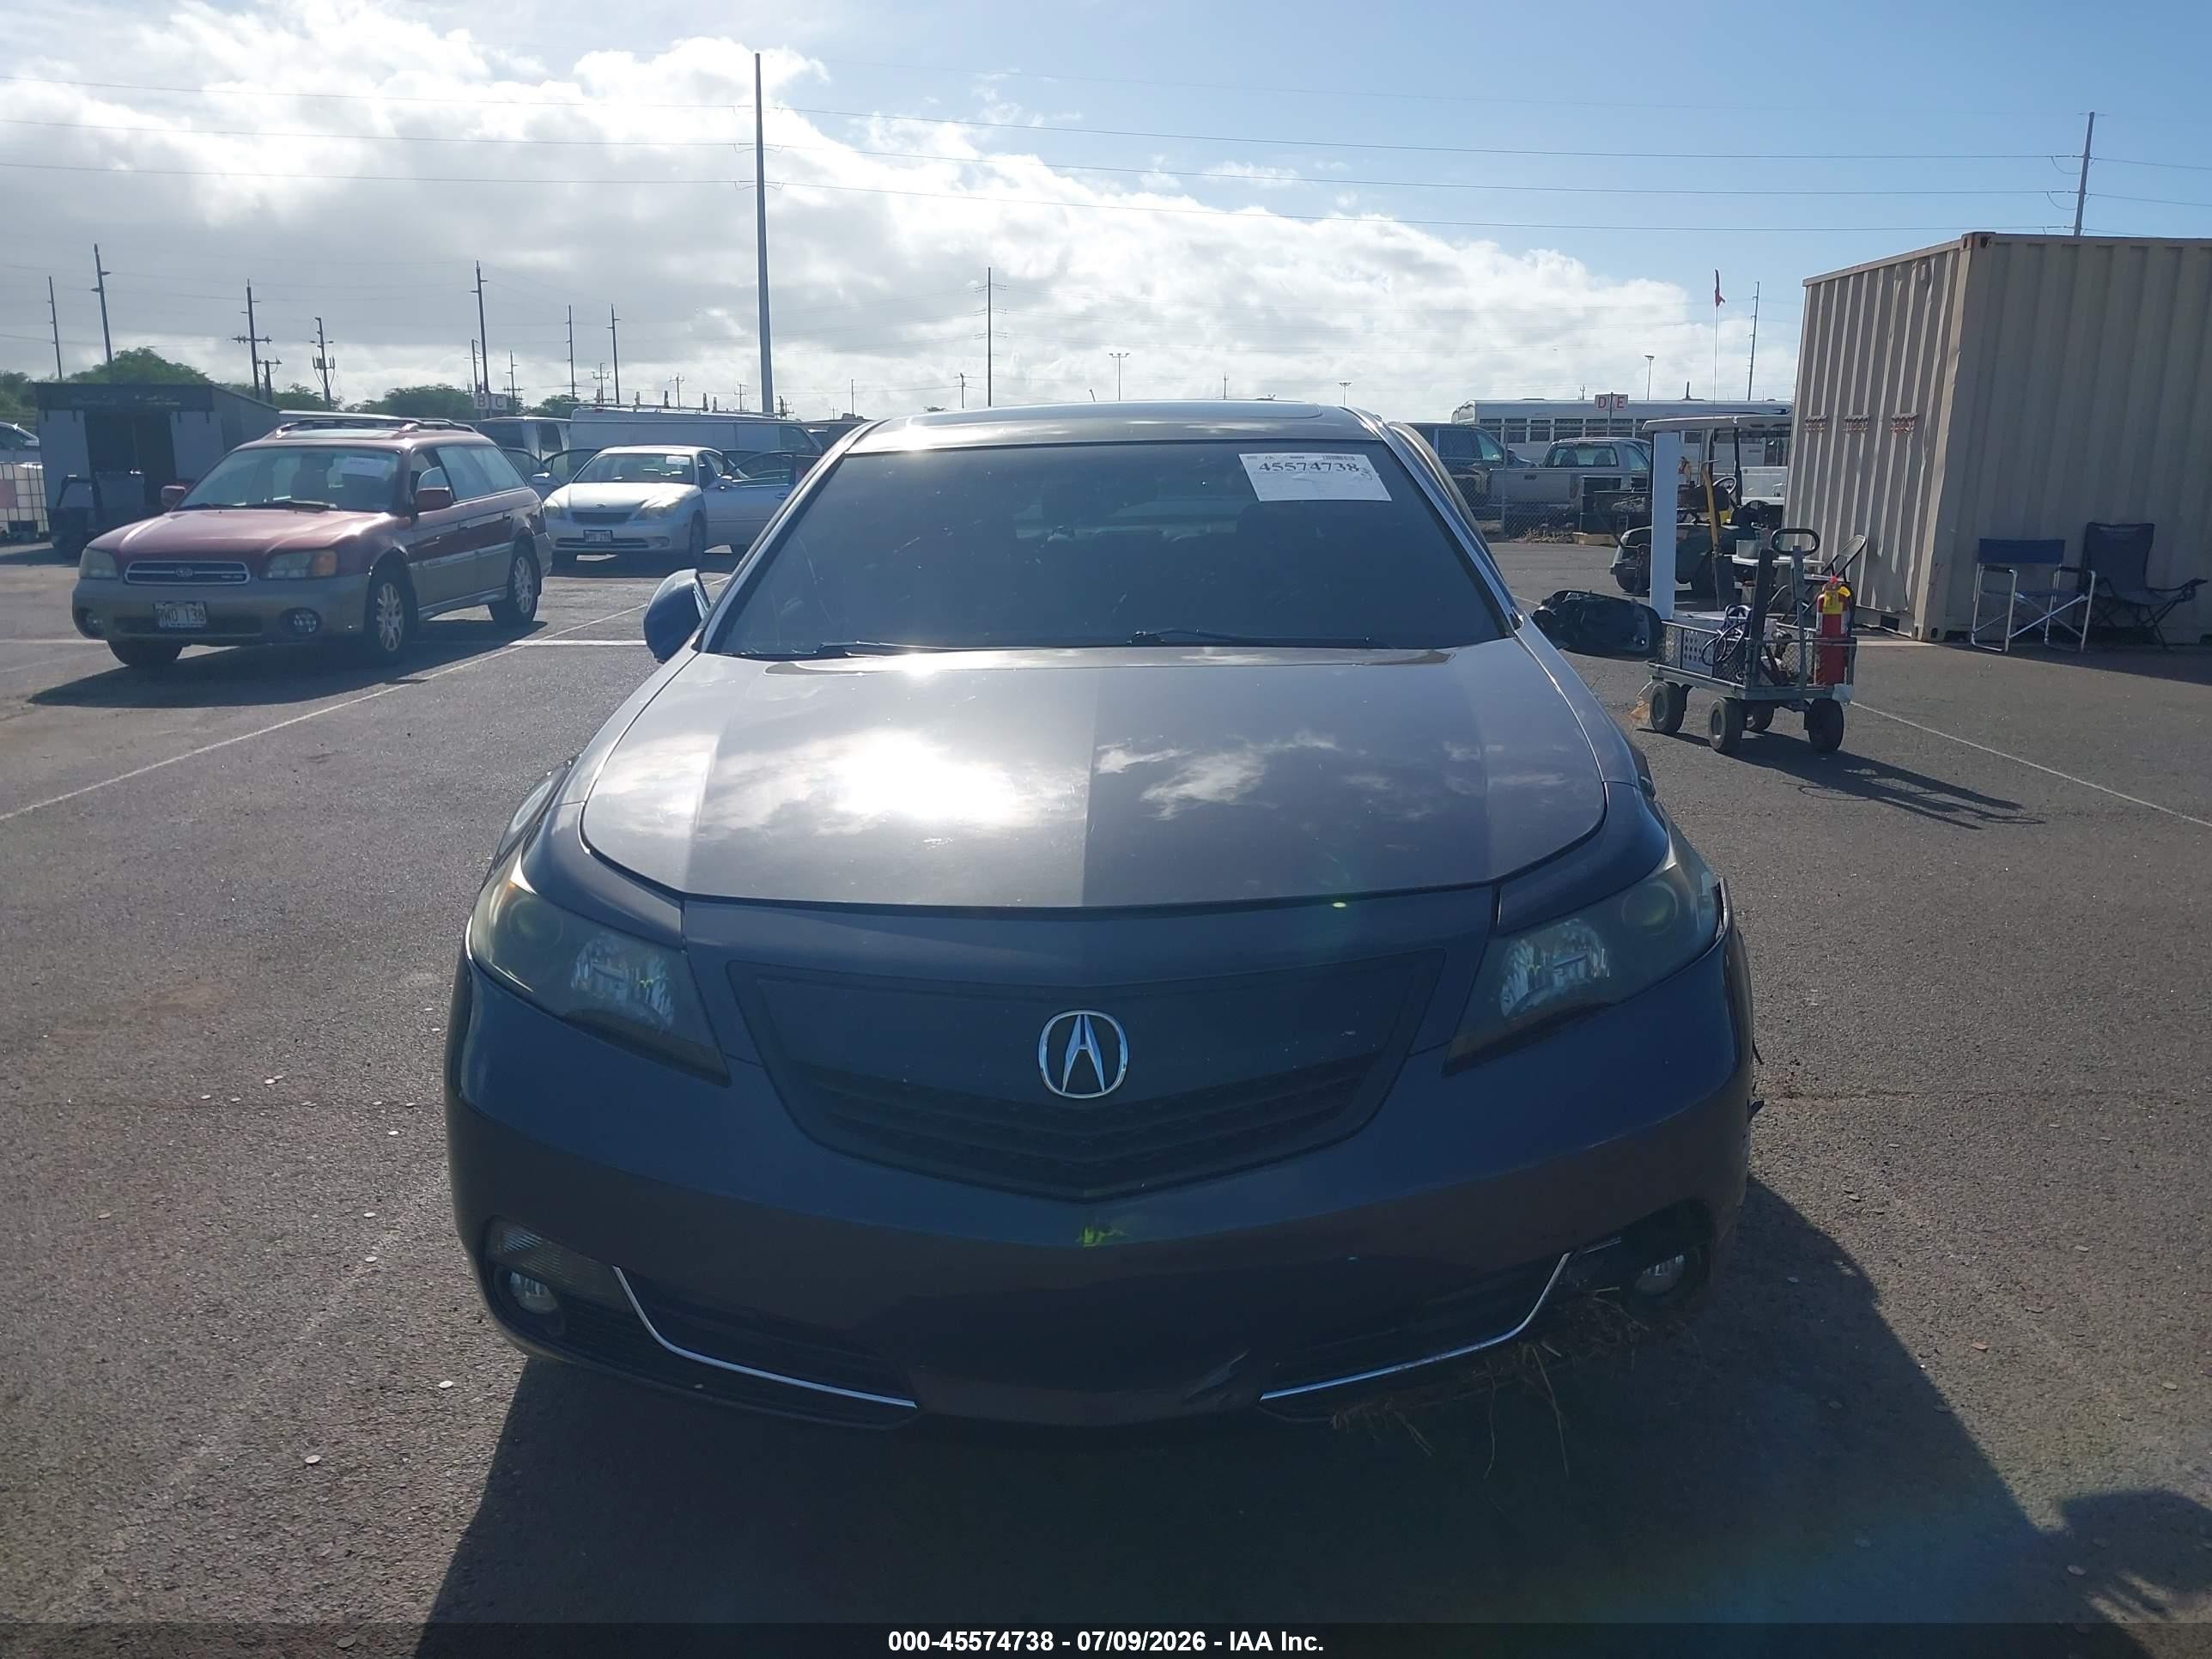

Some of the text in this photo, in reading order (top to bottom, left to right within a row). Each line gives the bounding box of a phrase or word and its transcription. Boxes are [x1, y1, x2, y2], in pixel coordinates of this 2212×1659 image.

[477, 395, 504, 408] B C
[1597, 396, 1626, 409] D E
[1258, 461, 1359, 472] 45574738
